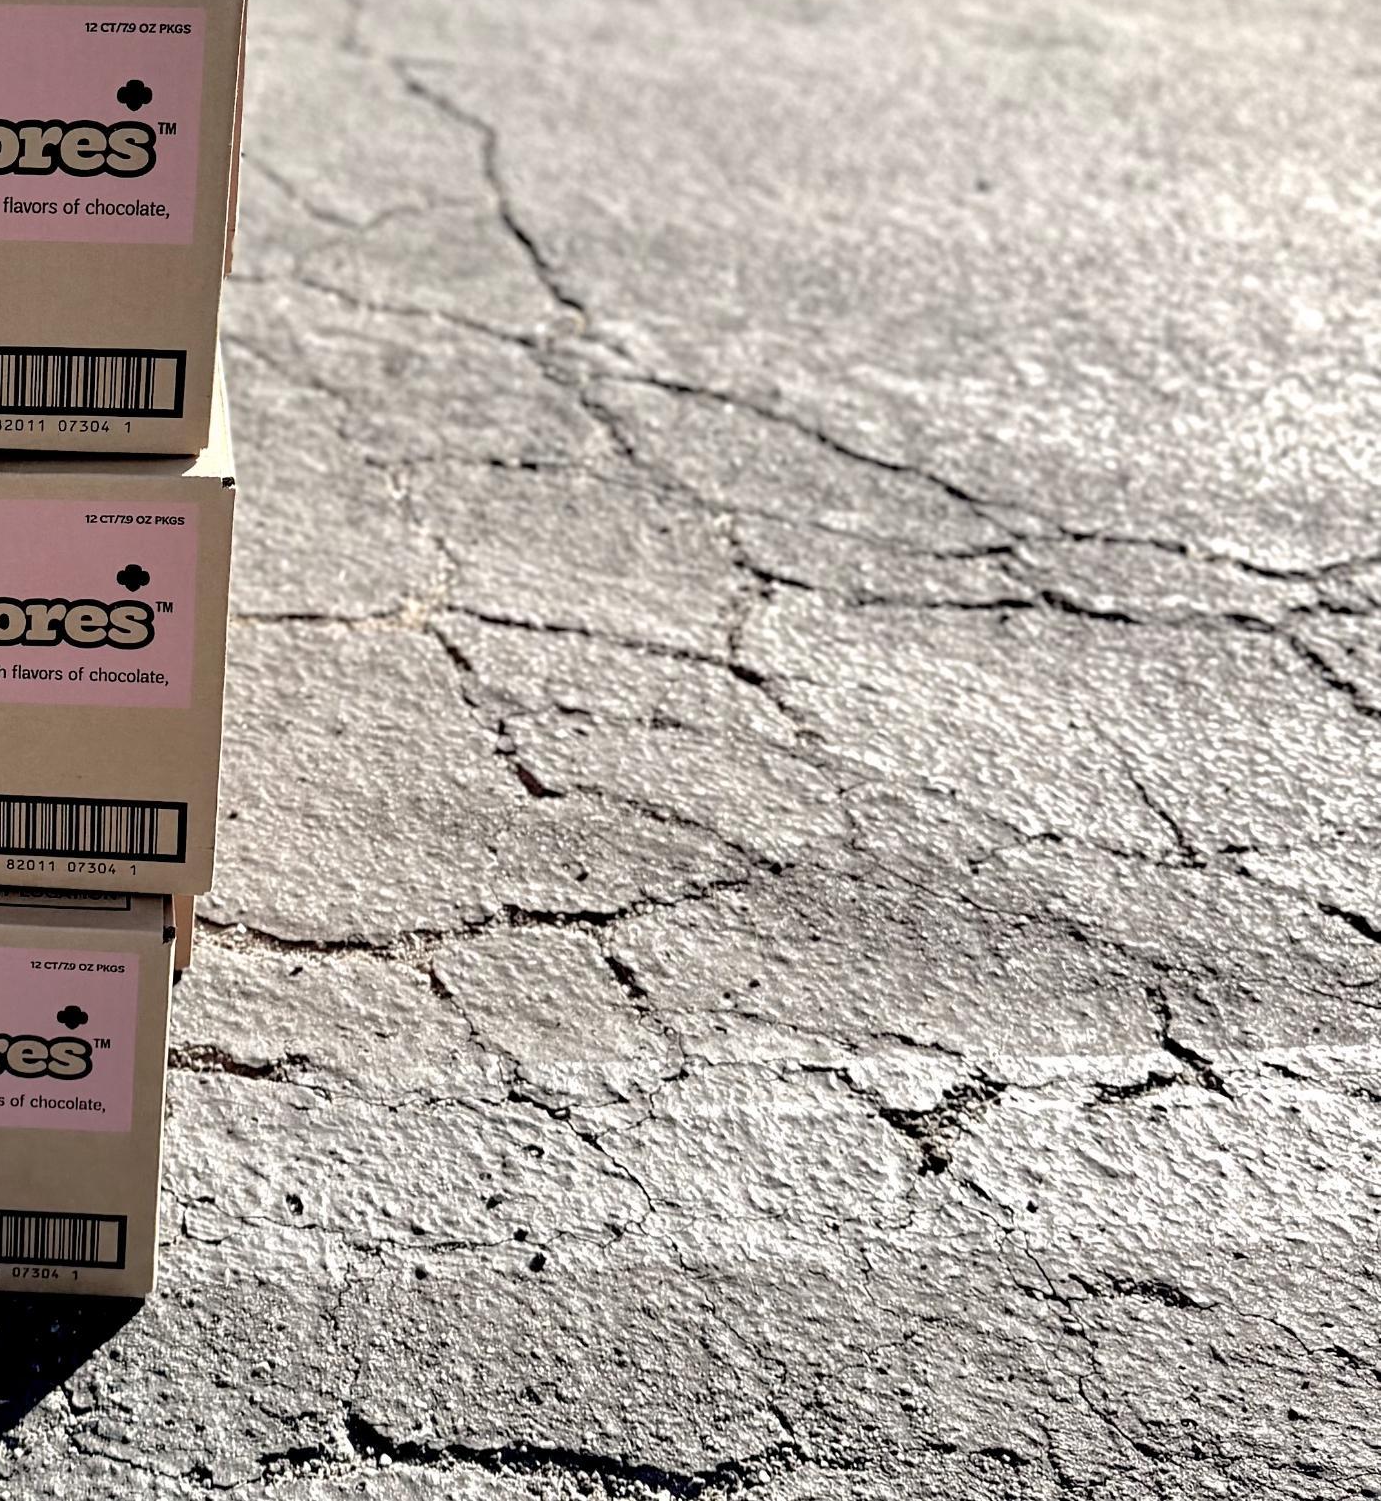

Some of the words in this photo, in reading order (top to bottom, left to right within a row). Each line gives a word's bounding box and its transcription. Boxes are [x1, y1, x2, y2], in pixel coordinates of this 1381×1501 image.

[4, 197, 57, 214] flavors
[63, 198, 80, 214] of
[86, 198, 169, 218] chocolate,
